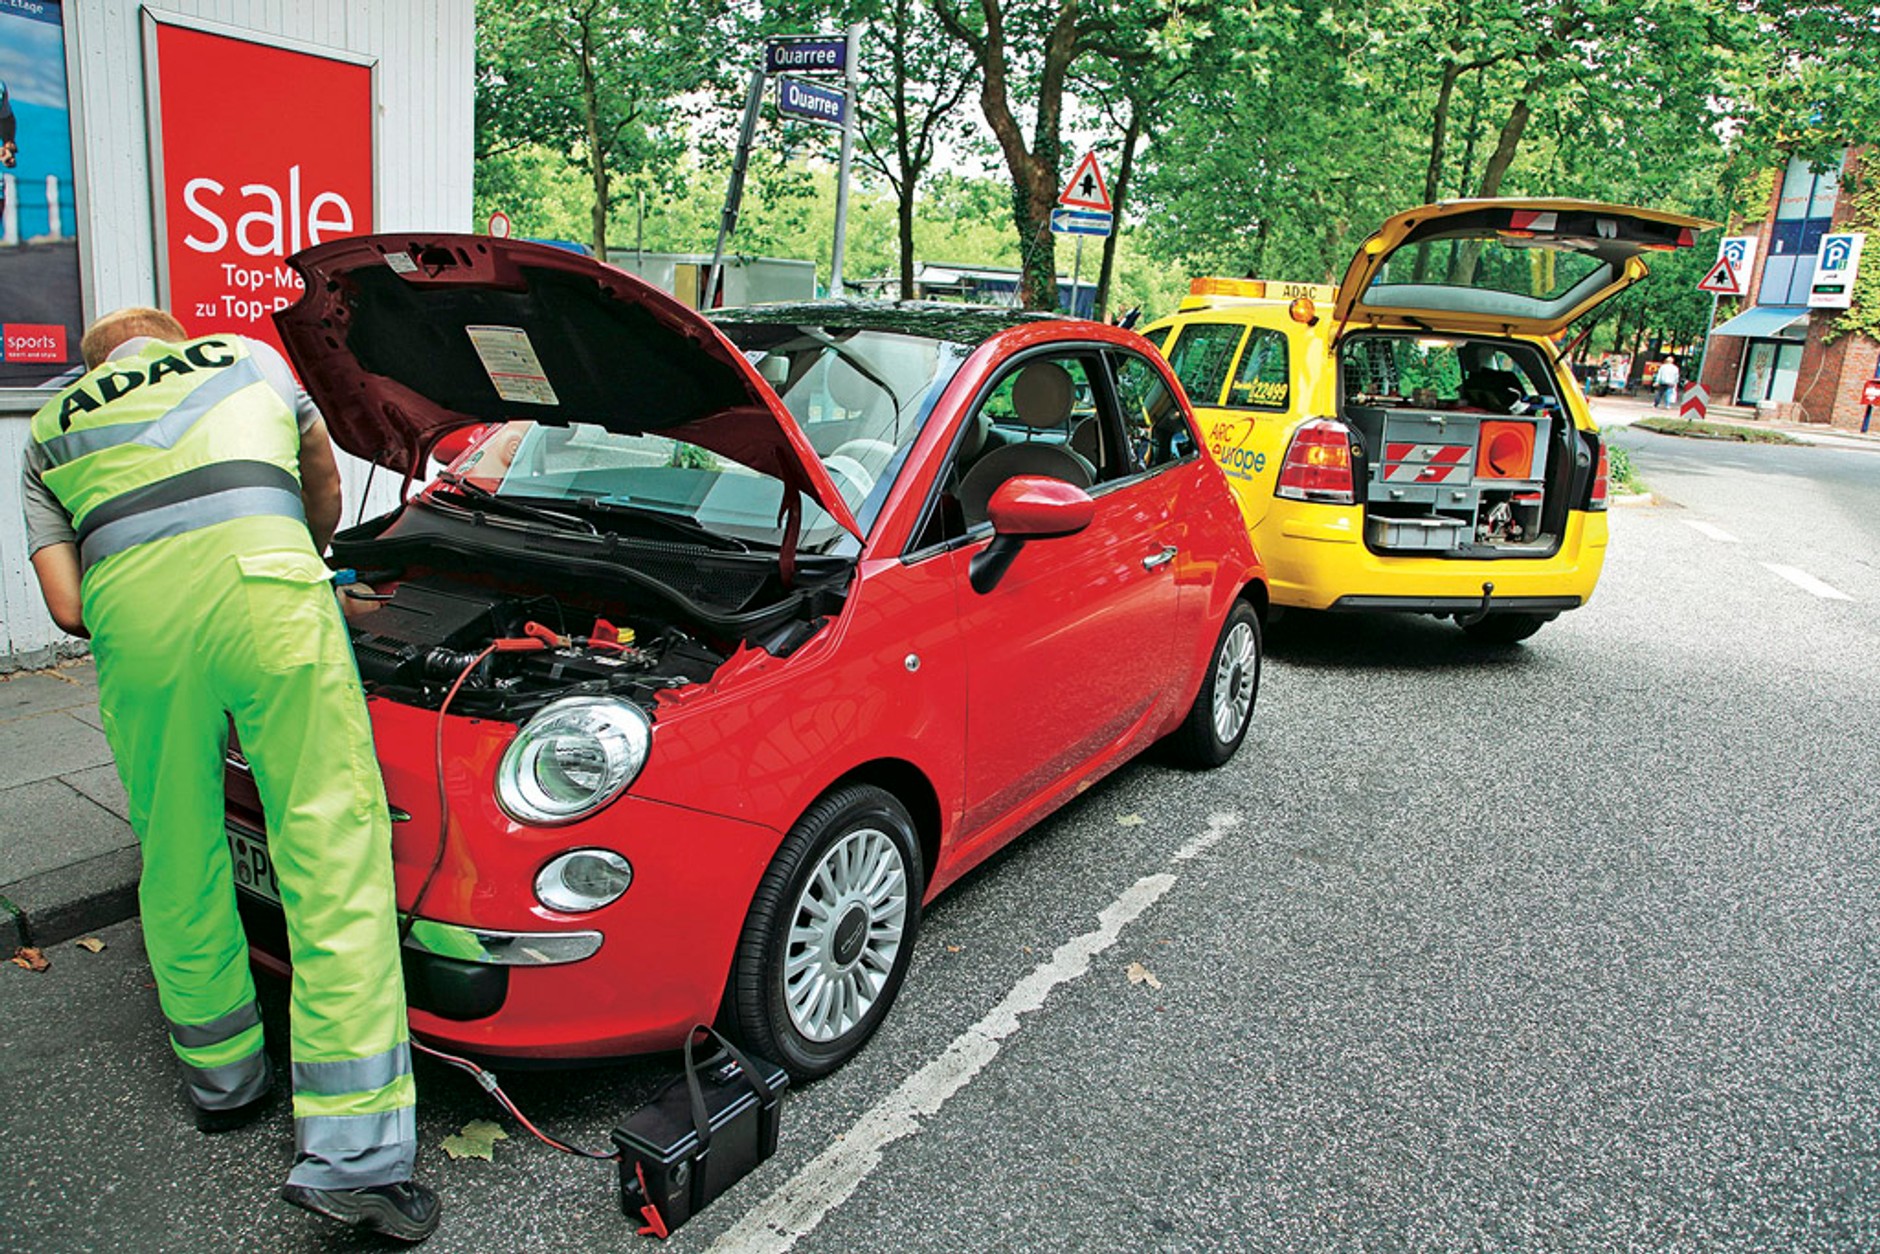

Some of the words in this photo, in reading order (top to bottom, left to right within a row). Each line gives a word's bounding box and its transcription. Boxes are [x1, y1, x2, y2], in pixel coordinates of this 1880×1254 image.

[774, 46, 837, 65] Quarree
[789, 85, 839, 116] Quarree
[183, 164, 354, 256] sale
[1282, 284, 1318, 299] ADAC
[195, 303, 216, 317] zu
[221, 296, 294, 322] Top-P
[7, 335, 57, 351] sports
[59, 341, 234, 432] ADAC
